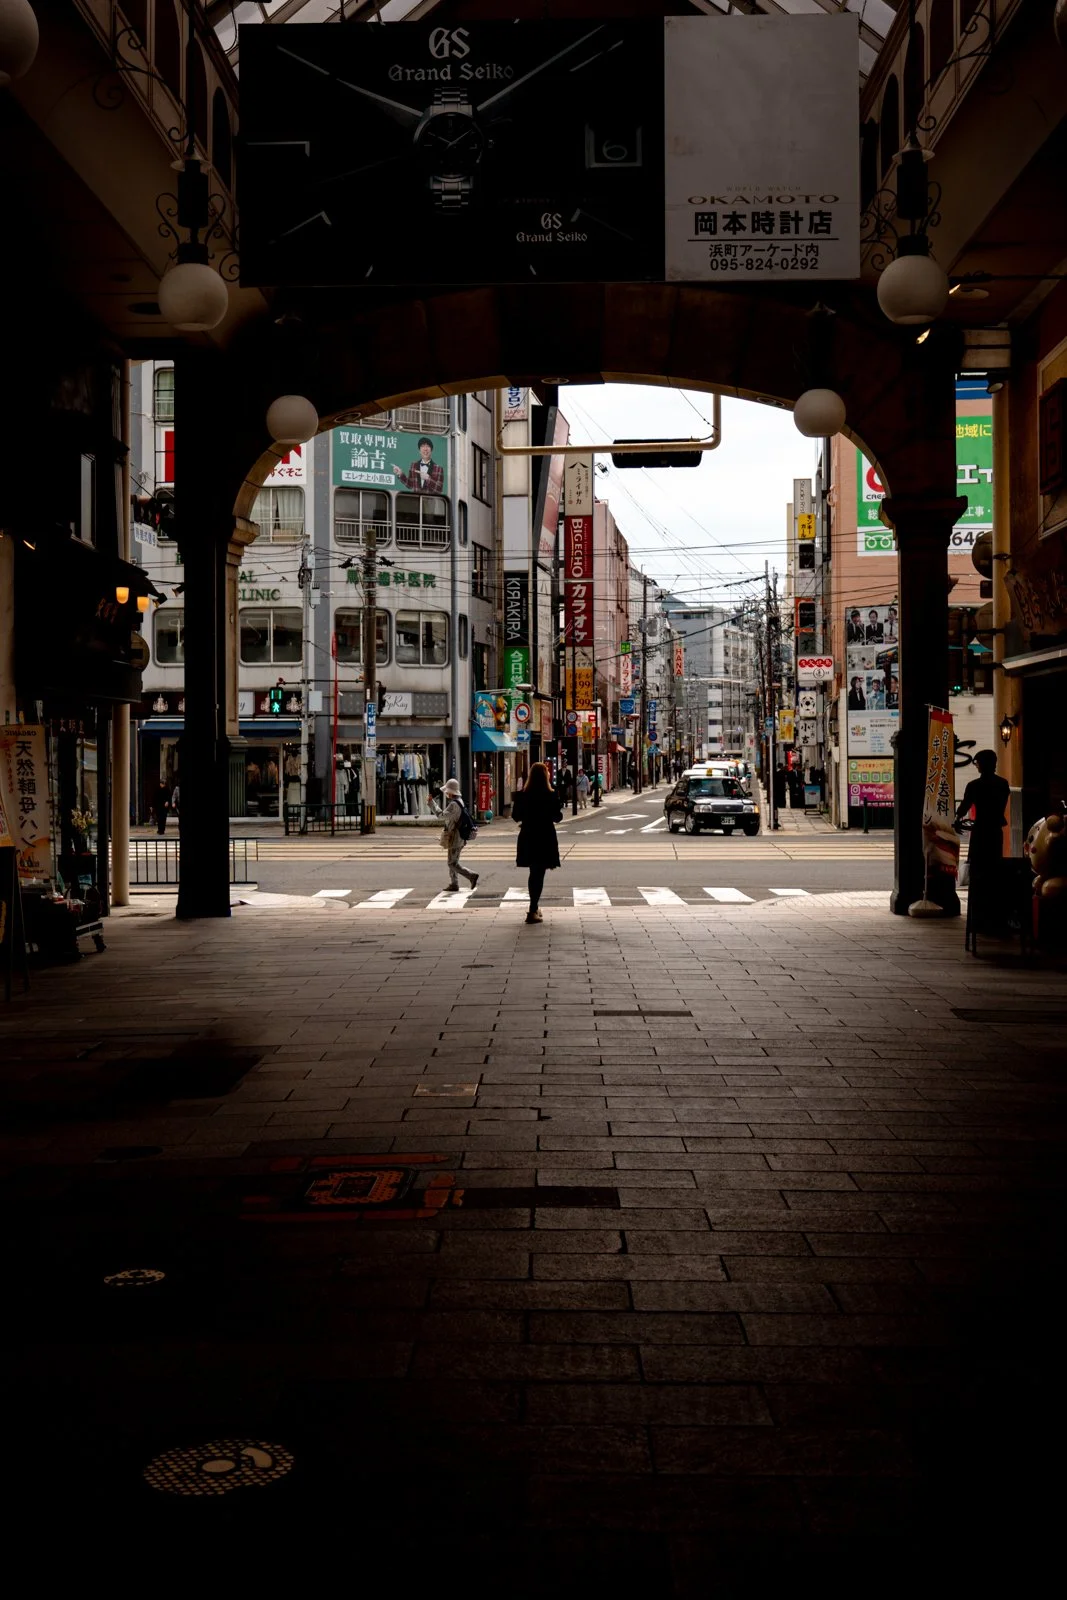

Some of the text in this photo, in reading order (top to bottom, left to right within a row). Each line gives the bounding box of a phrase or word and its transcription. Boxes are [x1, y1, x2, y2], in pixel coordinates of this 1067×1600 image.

[428, 26, 471, 59] GS
[388, 62, 515, 81] Grand Seiko
[687, 195, 839, 205] OKAMOTO
[694, 210, 832, 235] 岡本時計店
[516, 231, 588, 243] Grand Seiko
[709, 243, 819, 257] 浜町アーケード内
[709, 257, 818, 271] 095-824-0292
[339, 431, 398, 449] 買取専門店
[350, 448, 387, 470] 諭吉
[571, 518, 583, 578] BIG ECHO
[238, 589, 281, 601] LINIC
[571, 583, 588, 643] カラオケ
[924, 736, 941, 825] キャンペーン
